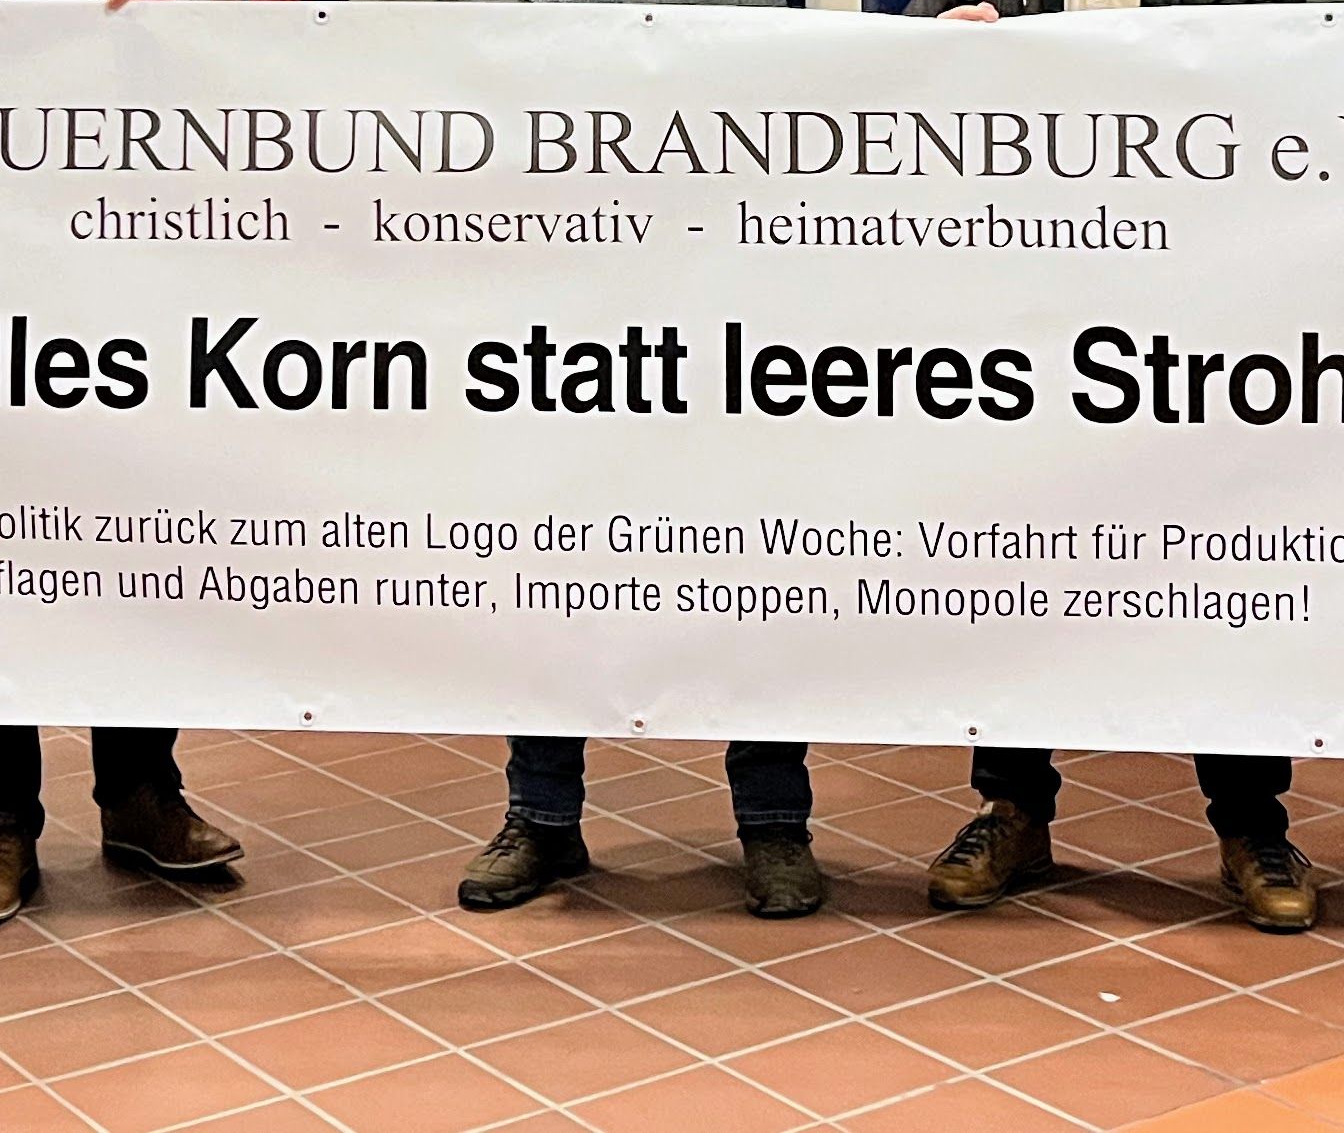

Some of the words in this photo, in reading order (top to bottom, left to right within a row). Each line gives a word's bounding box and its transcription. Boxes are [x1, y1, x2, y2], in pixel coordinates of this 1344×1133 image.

[523, 109, 1240, 180] BRANDENBURG
[70, 196, 290, 241] christlich
[373, 198, 654, 244] konservativ
[738, 200, 1170, 250] heimatverbunden
[189, 316, 428, 411] Korn
[465, 325, 688, 414] statt
[725, 321, 1035, 422] leeres
[94, 508, 218, 545] zurück
[230, 519, 306, 547] zum
[322, 511, 408, 549] alten
[427, 512, 518, 559] Logo
[533, 514, 594, 552] der
[608, 514, 744, 555] Grünen
[759, 518, 902, 558] Woche:
[918, 521, 1078, 560] Vorfahrt
[1091, 523, 1147, 560] für
[118, 565, 184, 600] und
[199, 566, 358, 610] Abgaben
[376, 573, 497, 614] runter,
[515, 572, 661, 618] Importe
[676, 576, 841, 622] stoppen,
[858, 578, 1049, 625] Monopole
[1063, 582, 1312, 629] zerschlagen!
